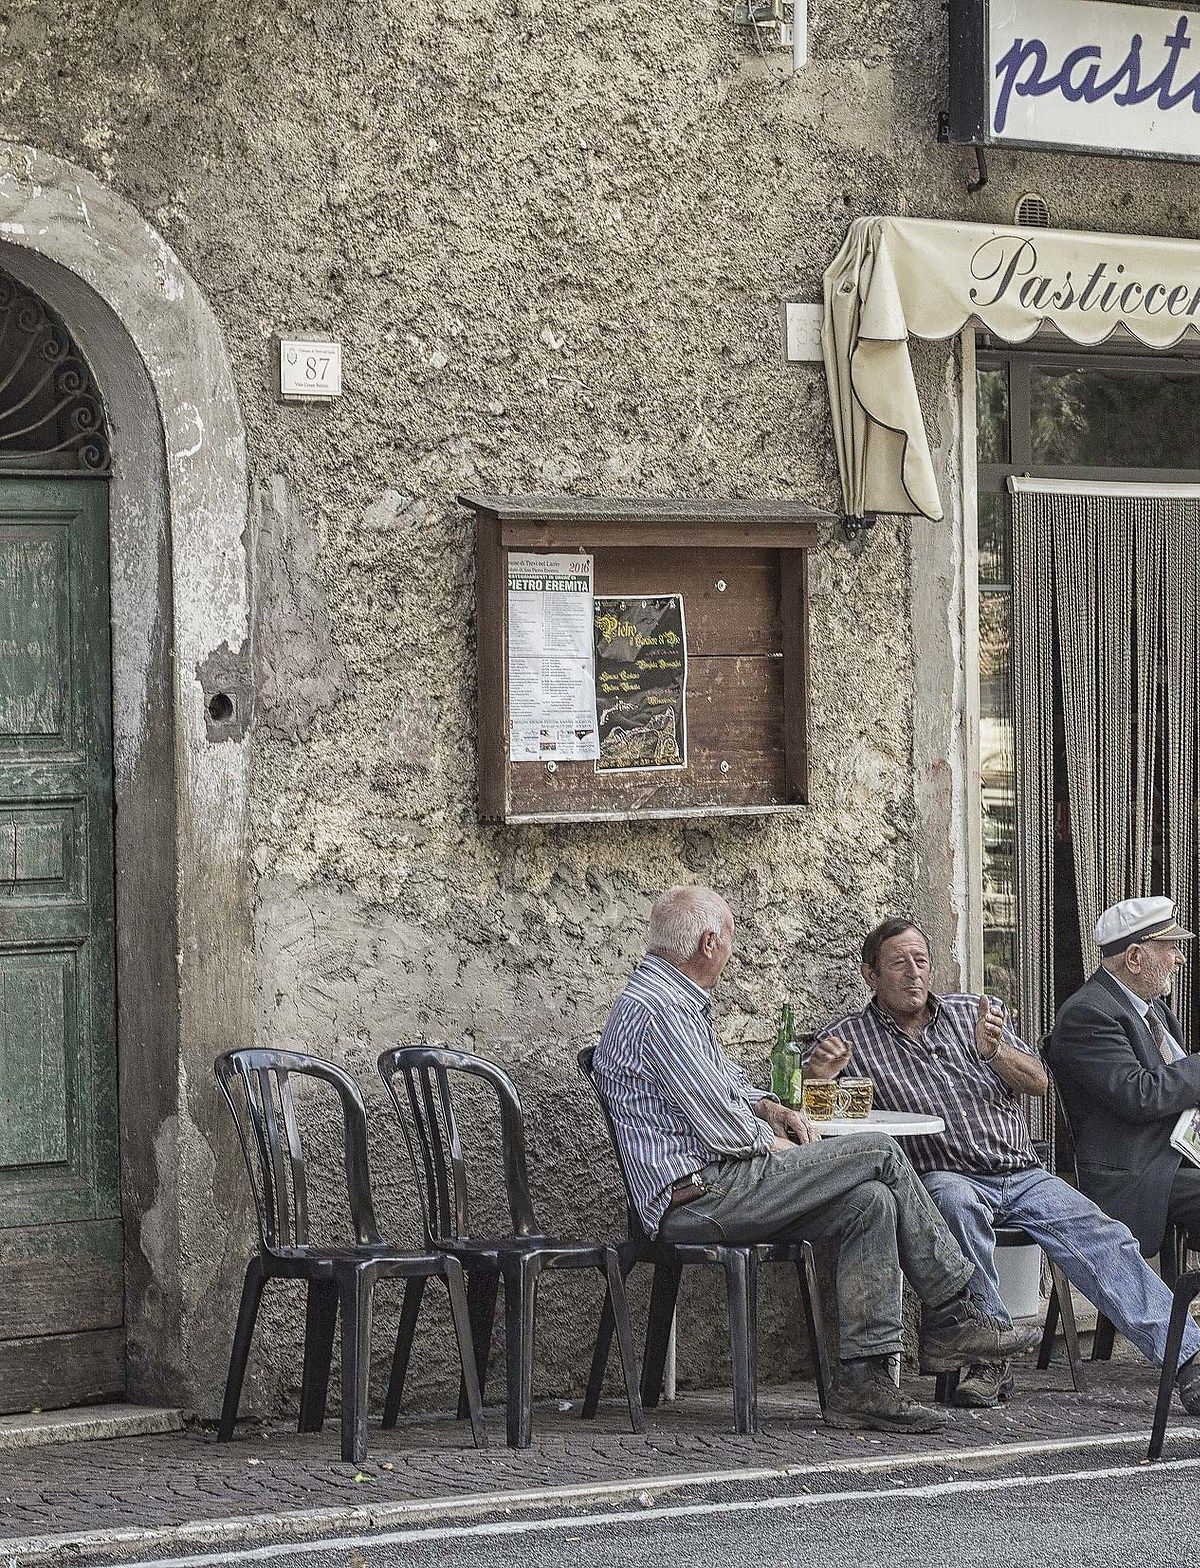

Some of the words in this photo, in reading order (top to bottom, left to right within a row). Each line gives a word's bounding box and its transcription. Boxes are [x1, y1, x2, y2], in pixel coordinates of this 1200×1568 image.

[306, 356, 331, 380] 87
[569, 562, 590, 573] 2016
[545, 580, 589, 593] EREMITA
